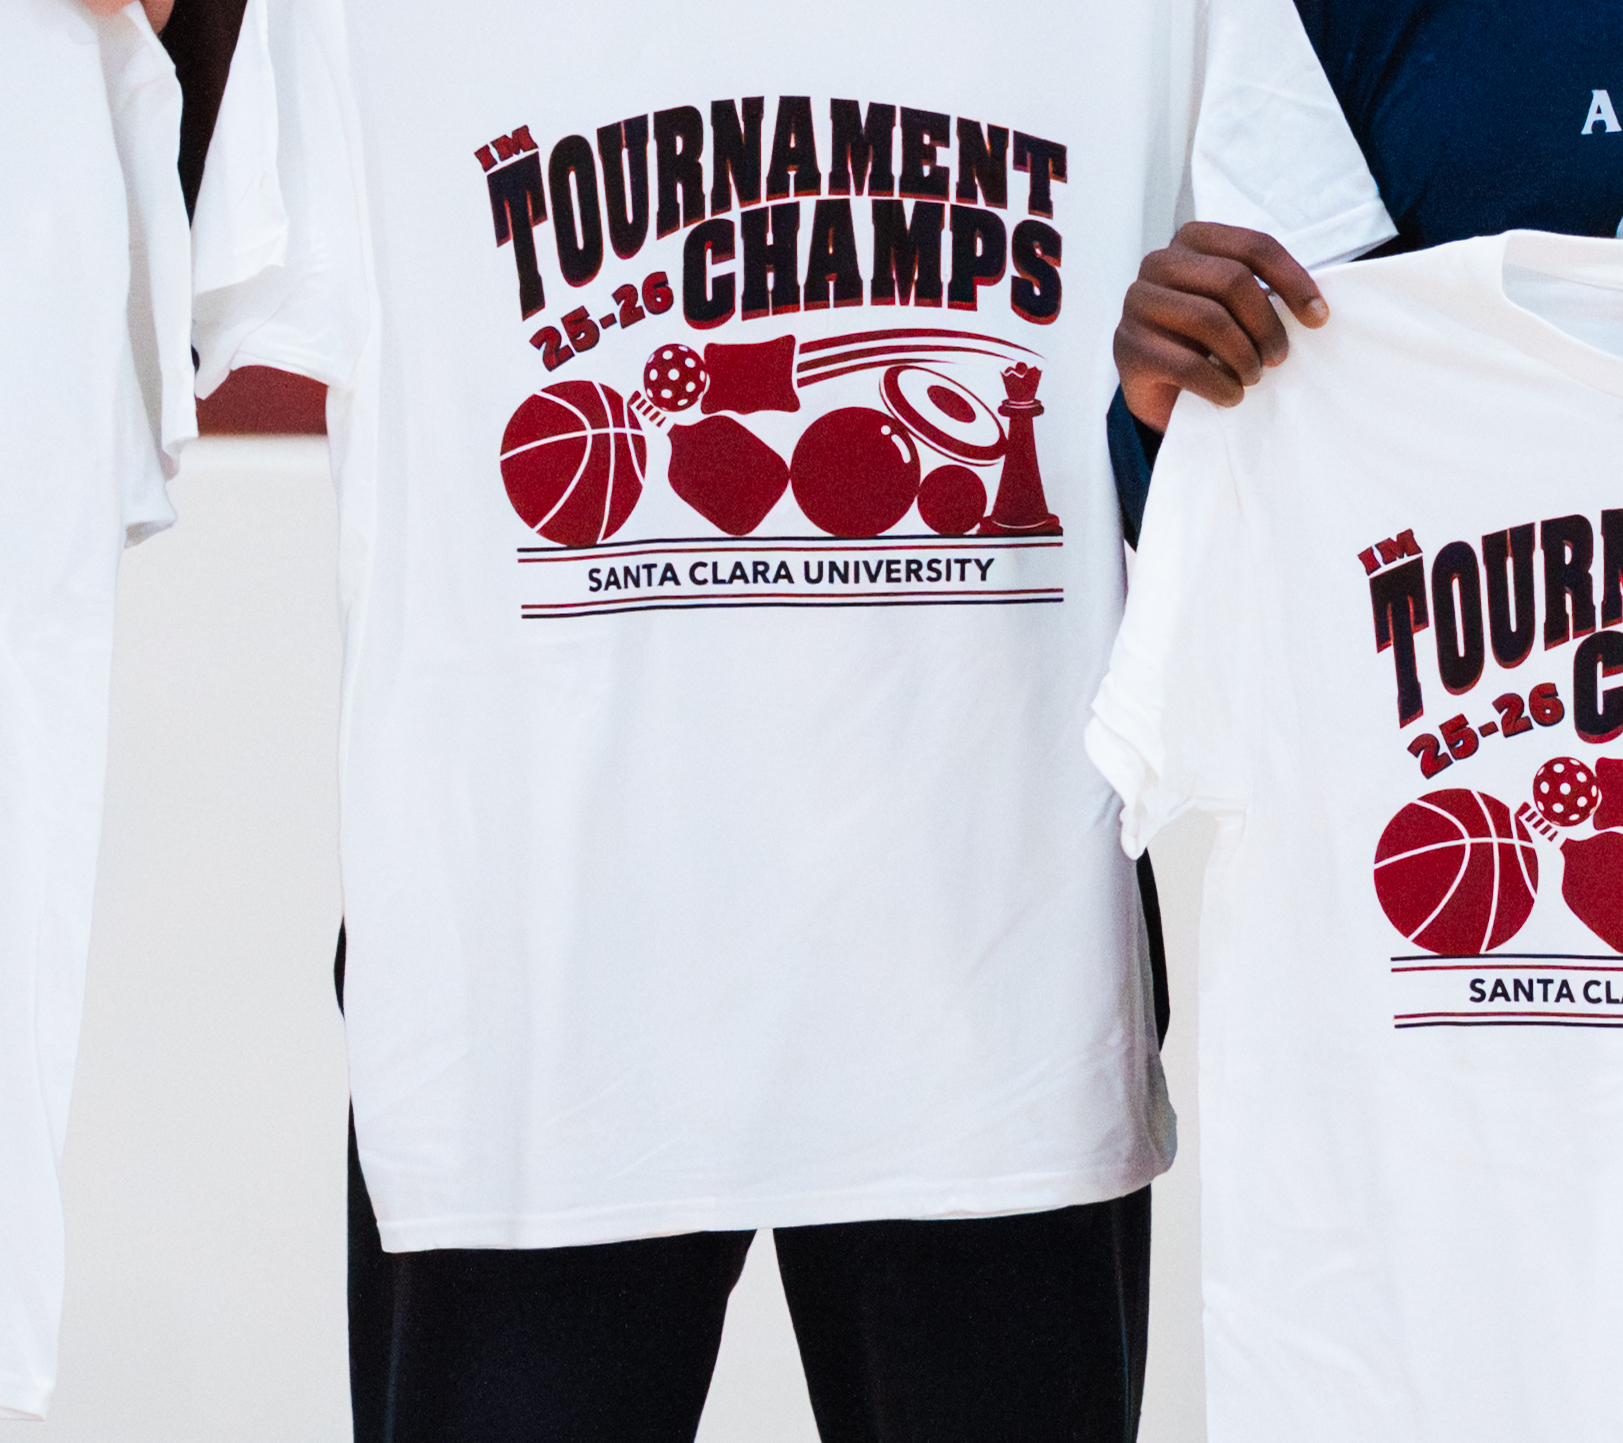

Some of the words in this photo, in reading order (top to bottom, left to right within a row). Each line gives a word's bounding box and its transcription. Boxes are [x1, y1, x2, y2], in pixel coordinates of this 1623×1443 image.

[474, 125, 539, 172] IM
[487, 95, 1067, 321] TOURNAMENT
[529, 271, 674, 372] 25-26
[682, 198, 1062, 330] CHAMPS
[587, 563, 681, 592] SANTA
[688, 560, 794, 586] CLARA
[803, 557, 994, 584] UNIVERSITY
[1357, 528, 1423, 575] IM
[1407, 682, 1565, 779] 25-26
[1469, 978, 1575, 1003] SANTA
